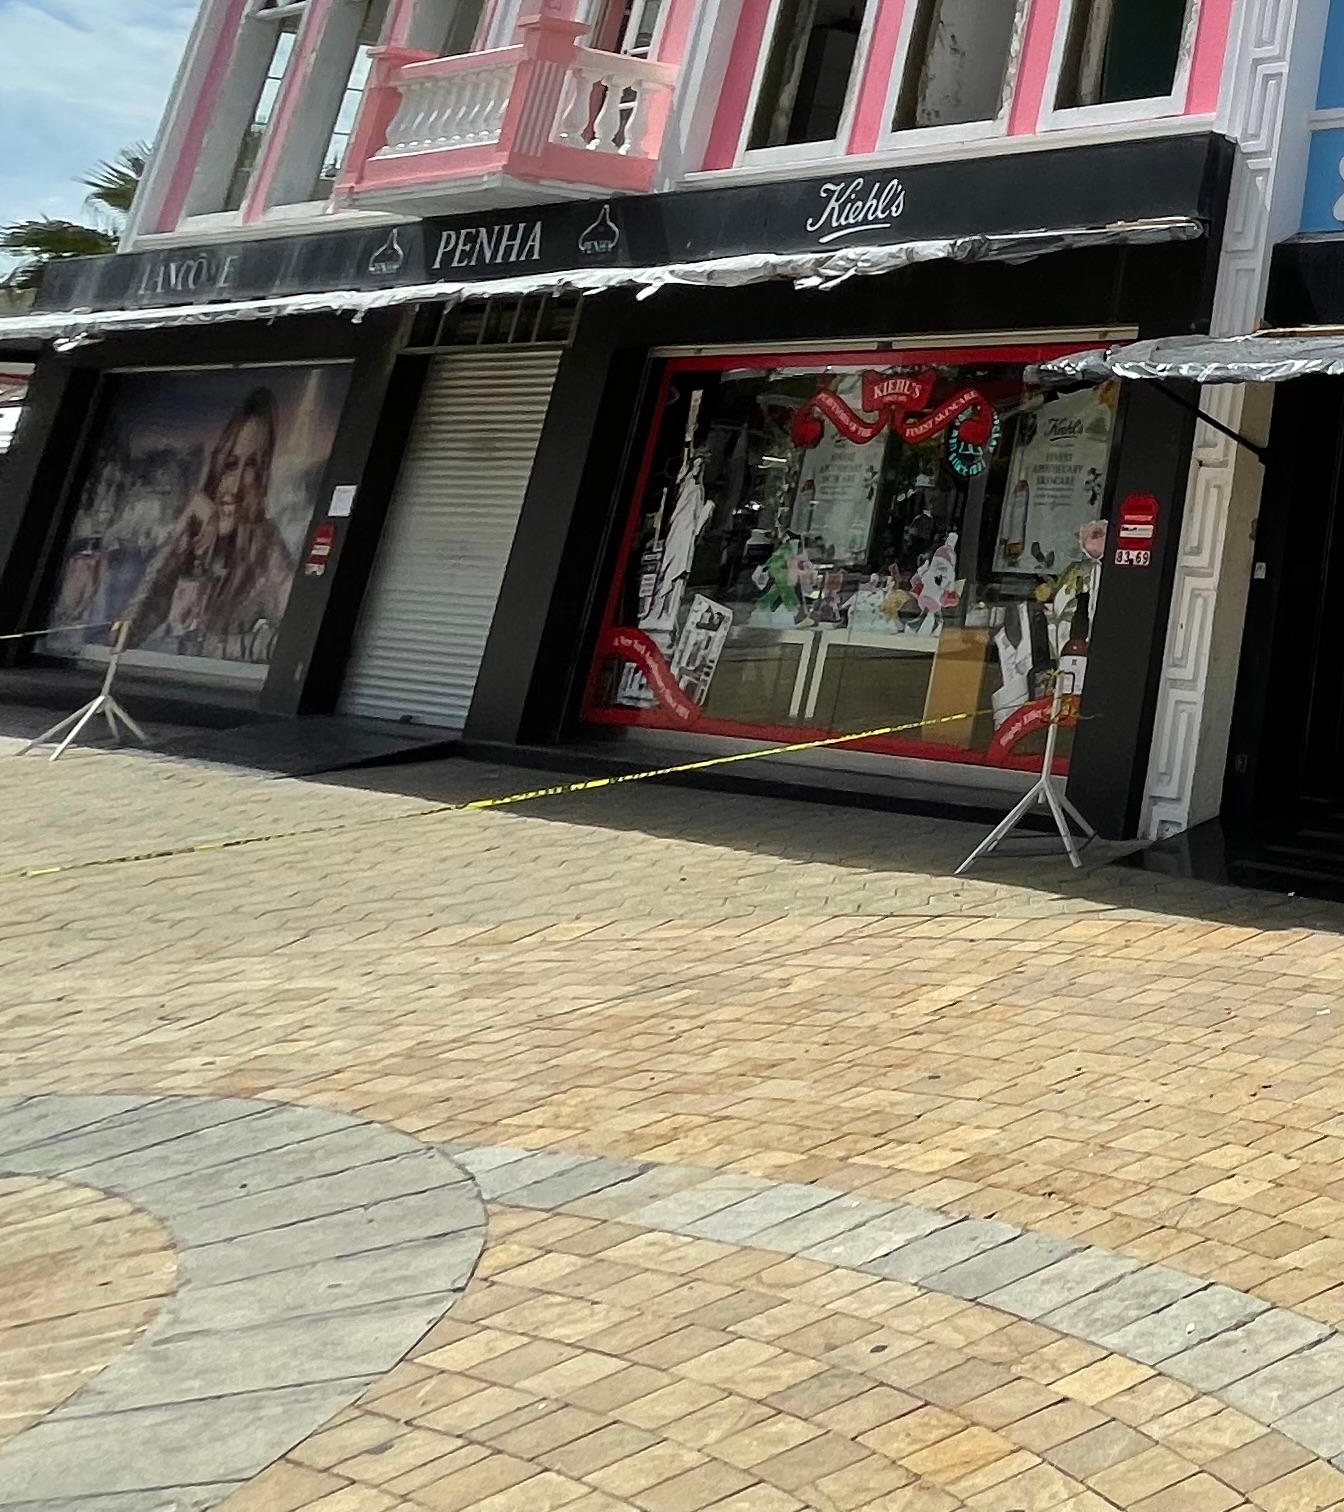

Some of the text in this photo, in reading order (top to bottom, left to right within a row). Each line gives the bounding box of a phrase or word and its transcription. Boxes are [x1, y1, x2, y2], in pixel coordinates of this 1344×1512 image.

[806, 177, 905, 232] Kiehl's
[431, 220, 543, 270] PENHA
[873, 378, 923, 399] KIEHL'S
